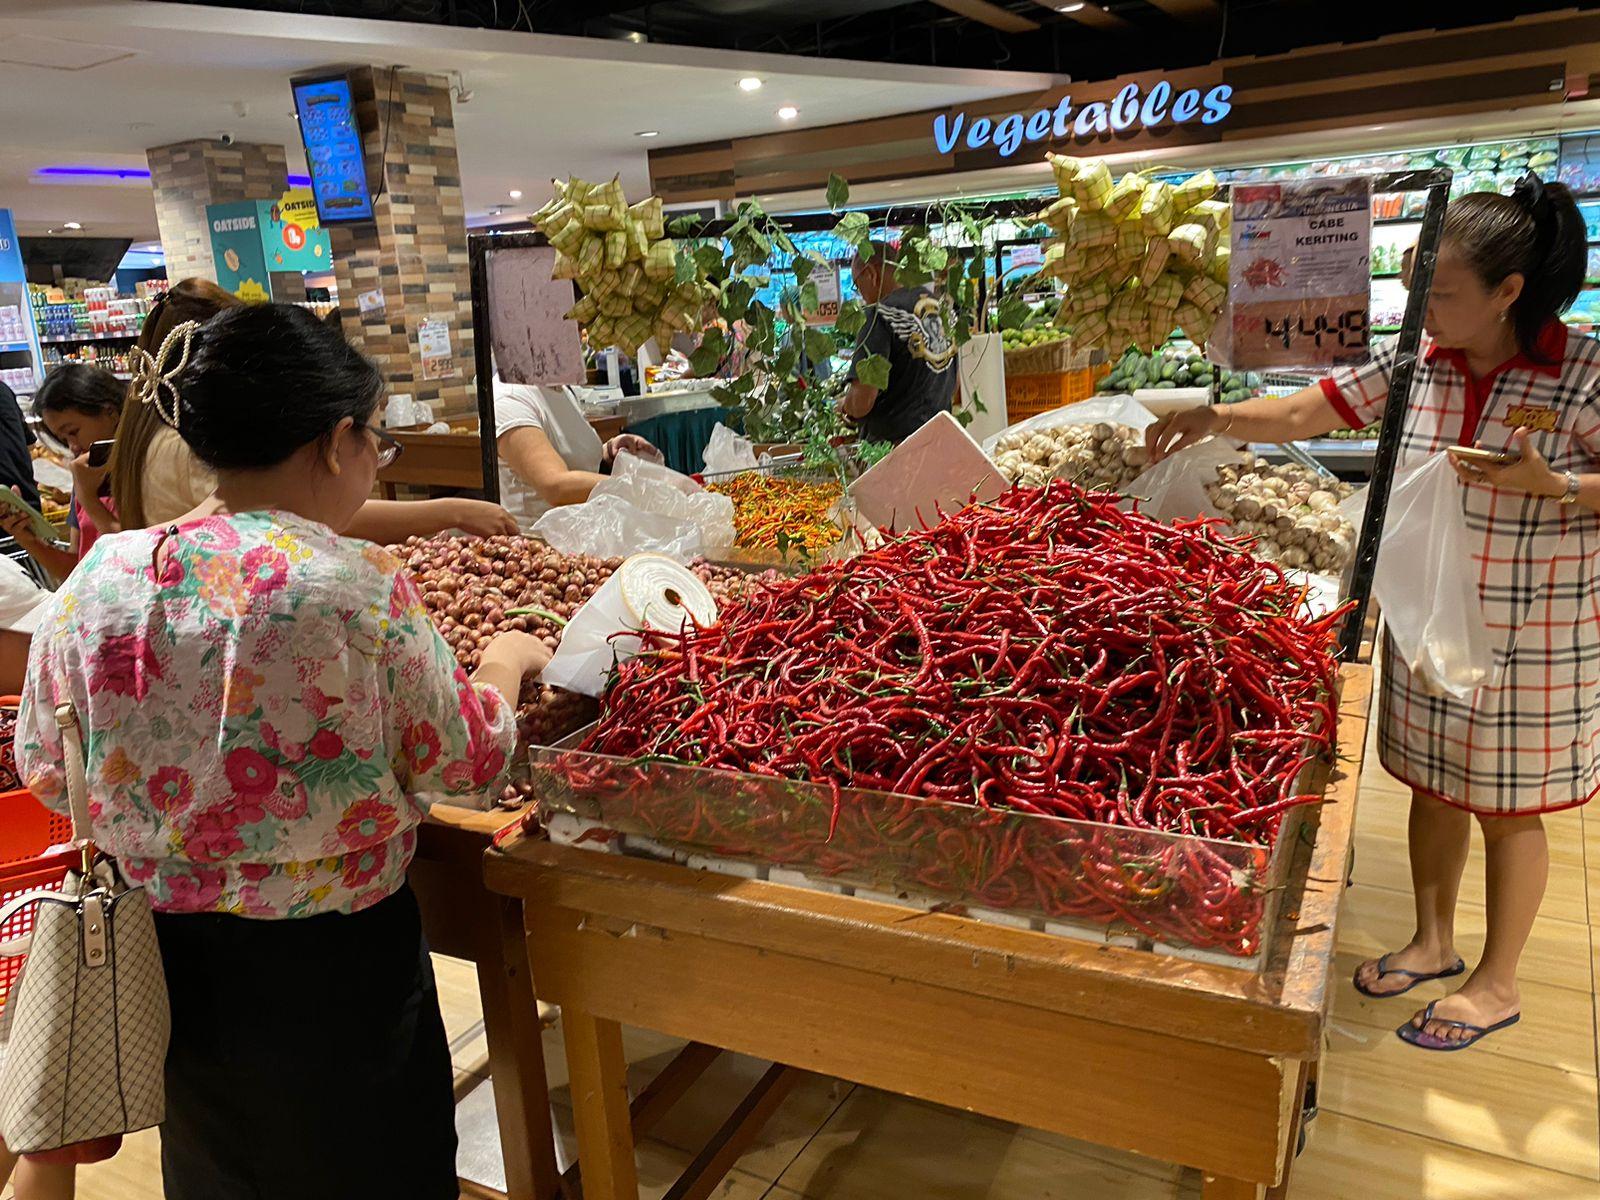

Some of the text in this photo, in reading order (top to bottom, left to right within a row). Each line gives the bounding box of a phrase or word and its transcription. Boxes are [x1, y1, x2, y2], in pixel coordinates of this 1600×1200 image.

[933, 80, 1233, 157] Vegetables
[285, 200, 315, 211] OATSID
[213, 216, 256, 232] OATSIDE
[1309, 218, 1345, 230] CABE
[1295, 232, 1359, 247] KERITING
